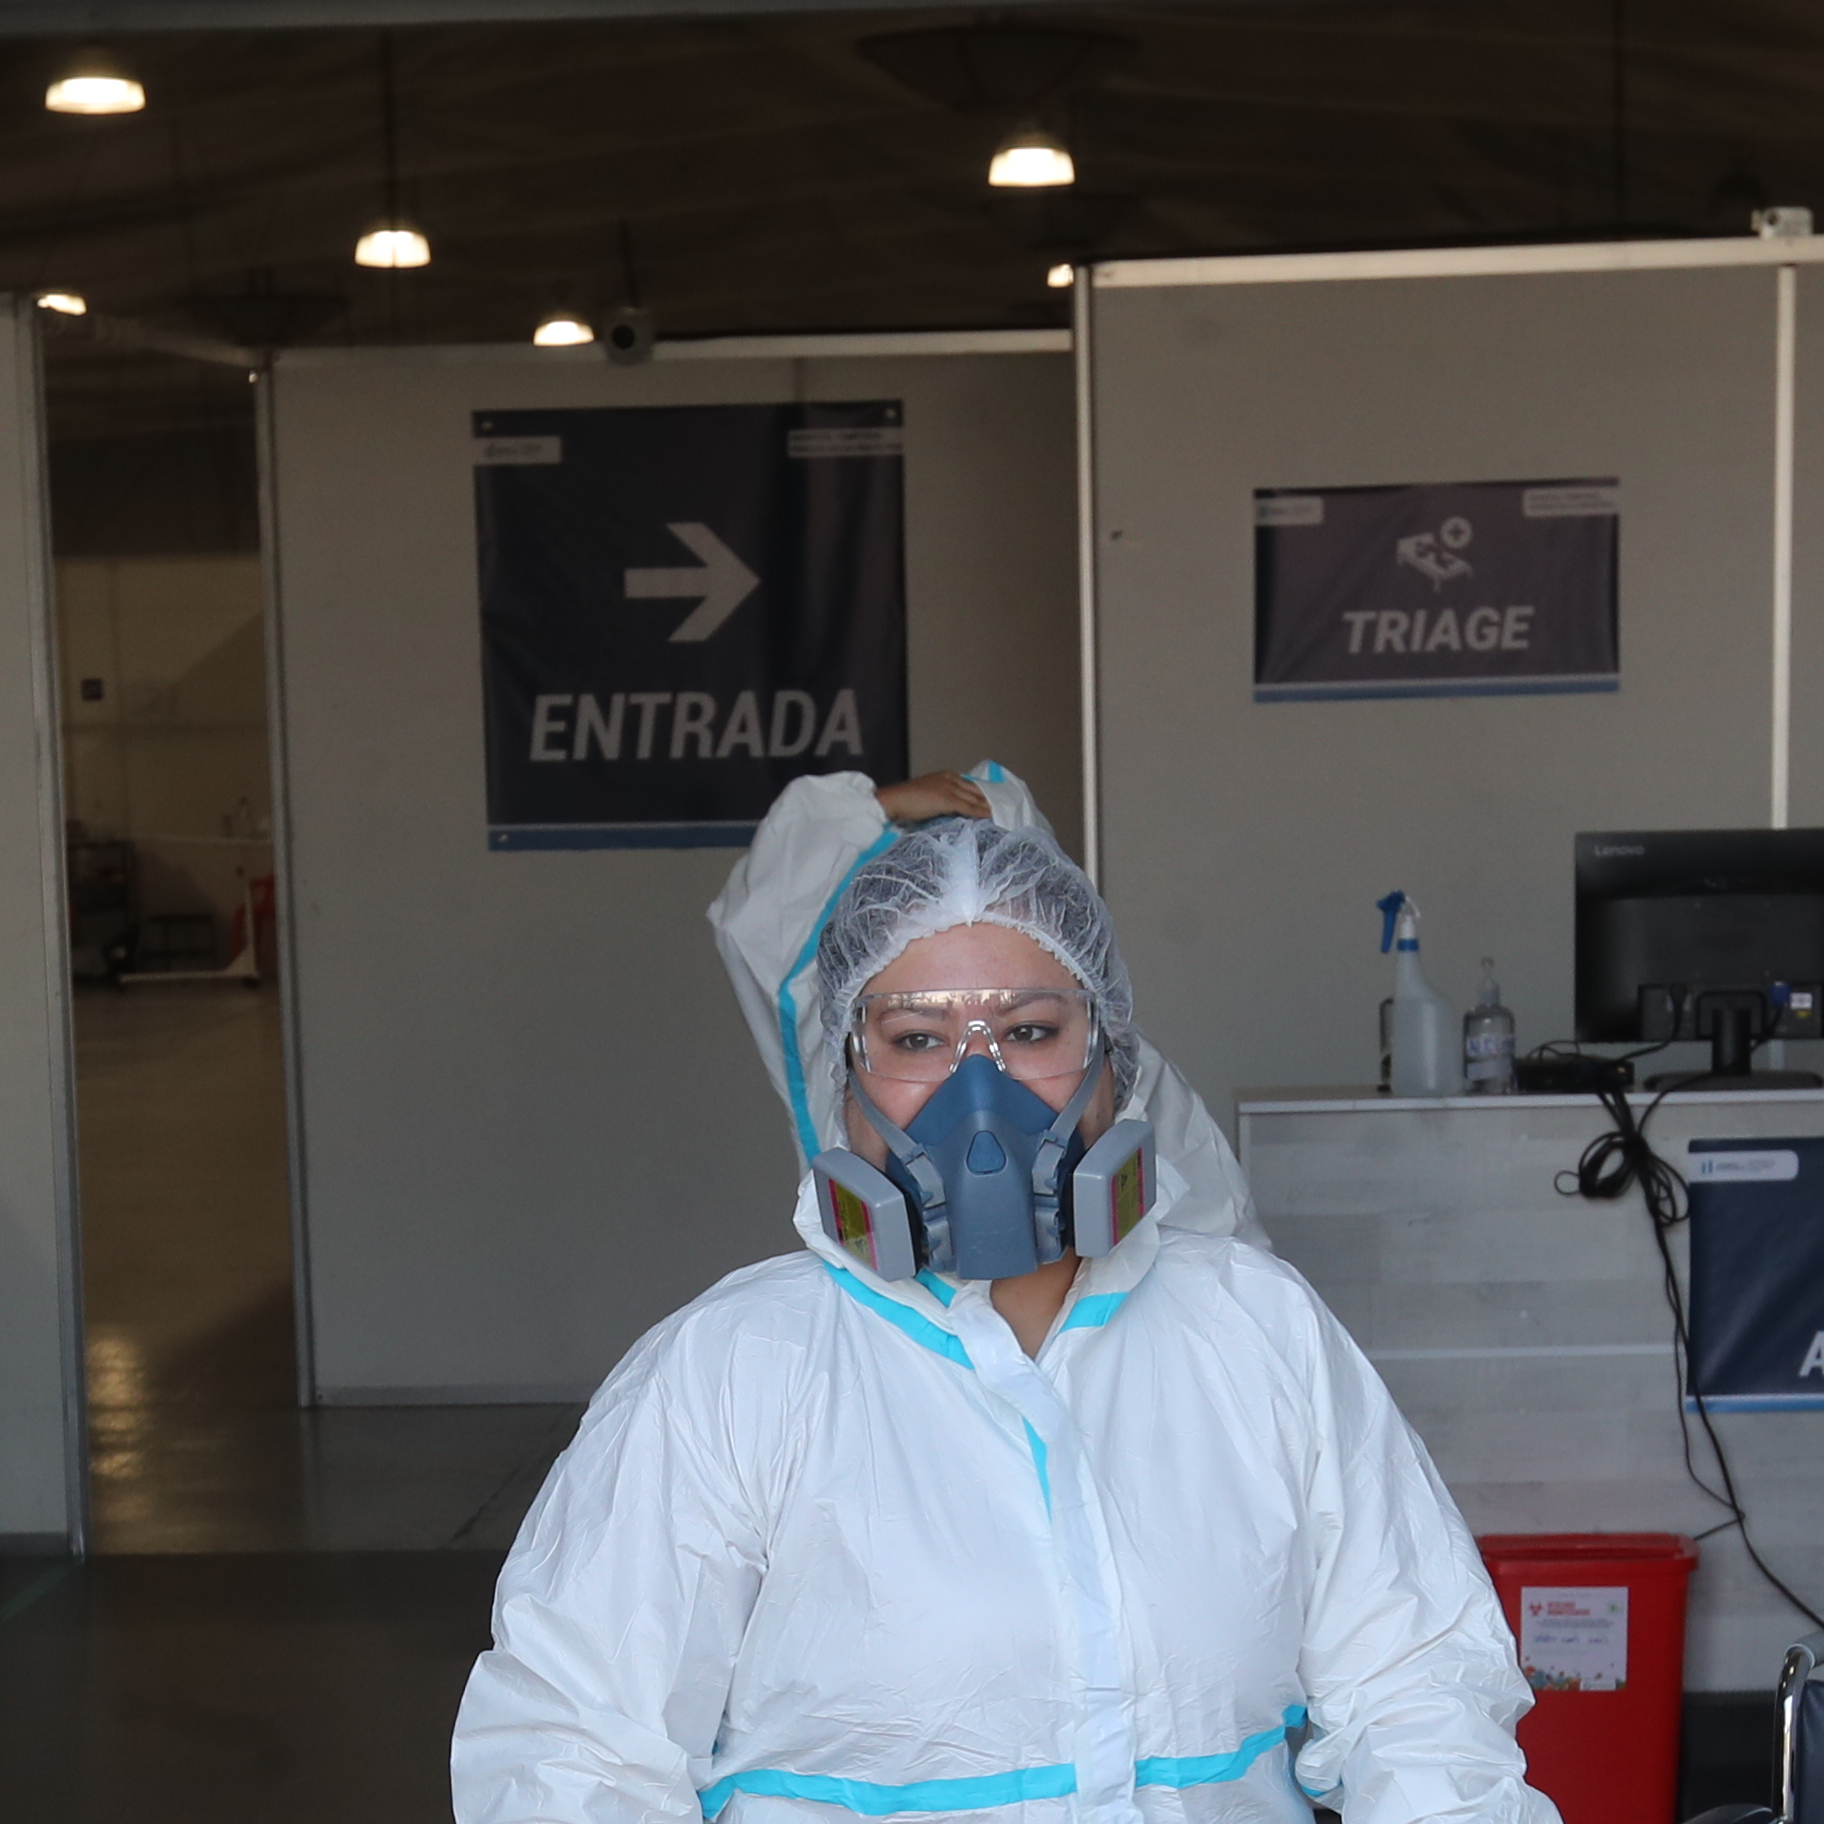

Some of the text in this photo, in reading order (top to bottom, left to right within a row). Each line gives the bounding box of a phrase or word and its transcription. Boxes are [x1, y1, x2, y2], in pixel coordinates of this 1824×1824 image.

[1342, 605, 1535, 654] TRIAGE
[529, 688, 864, 762] ENTRADA
[1594, 844, 1645, 857] Lenovo
